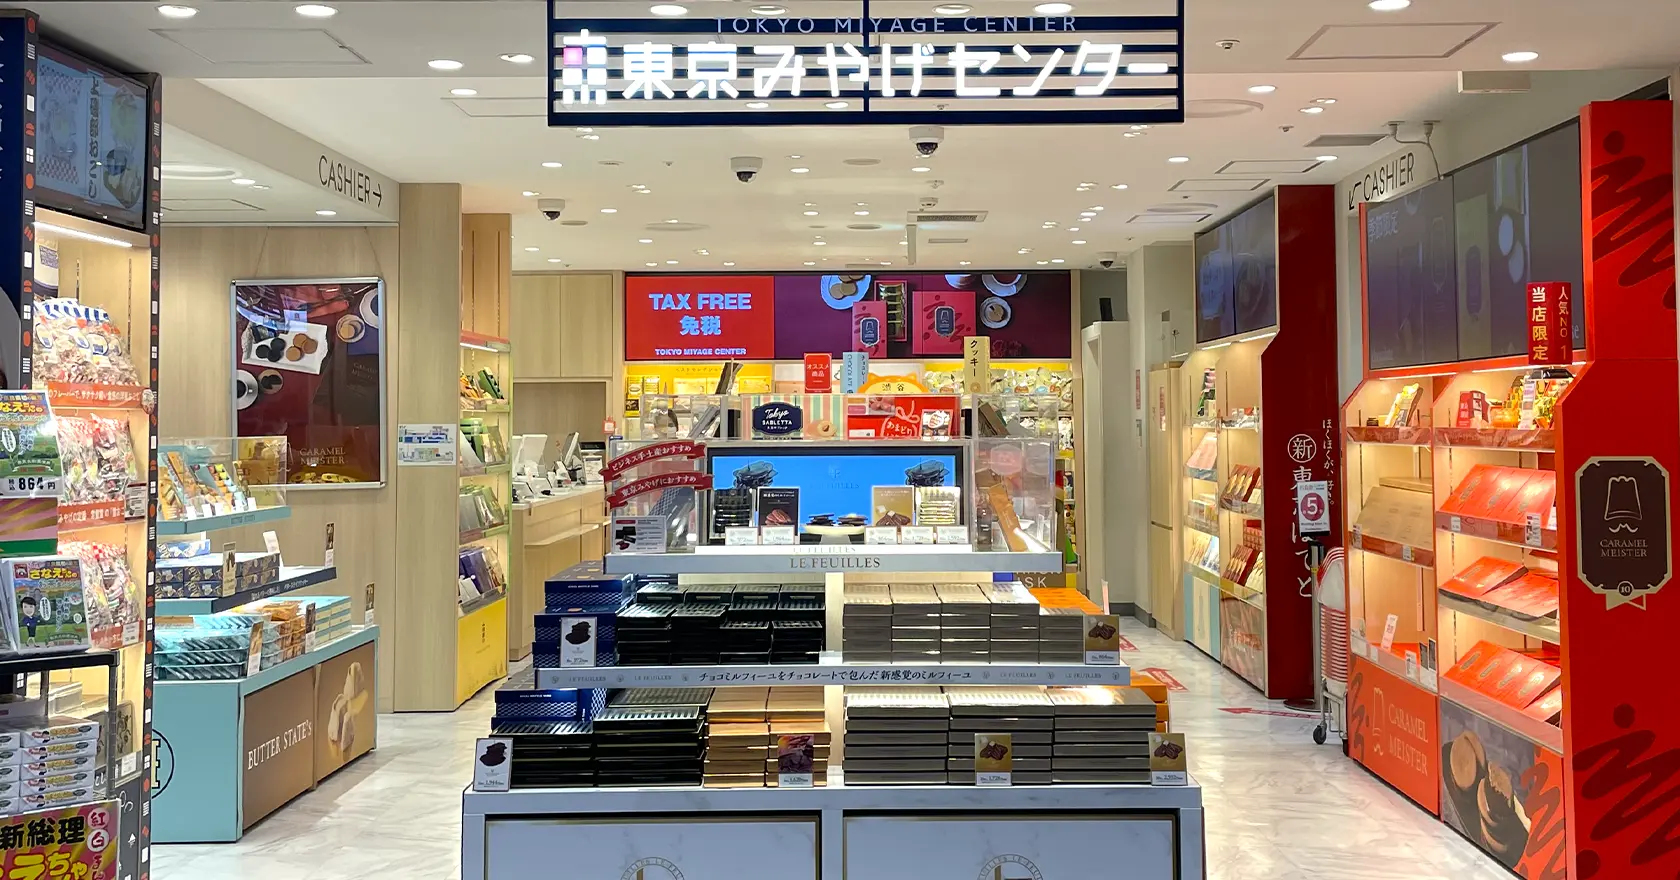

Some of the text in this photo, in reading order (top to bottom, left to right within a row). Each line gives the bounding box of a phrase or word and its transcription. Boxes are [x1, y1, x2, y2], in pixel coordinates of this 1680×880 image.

[714, 16, 1076, 34] TOKYO MIYAGE CENTER
[621, 39, 1169, 100] 東京みやげセンター
[318, 154, 371, 205] CASHIER
[1363, 151, 1415, 202] CASHIER
[648, 293, 752, 310] TAX FREE
[679, 315, 722, 336] 免税
[1532, 286, 1549, 360] 当店限定
[654, 348, 682, 356] TOKYO
[970, 339, 978, 377] クッキー
[882, 383, 905, 393] 渋谷
[887, 421, 913, 435] あまどり
[300, 448, 346, 456] CARAMEL
[611, 445, 692, 471] ビジネス手土産おすすめ
[1292, 436, 1314, 460] 新
[621, 475, 697, 497] 東京みやげにおすすめ
[1307, 496, 1318, 516] 5
[1600, 539, 1648, 548] CARAMEL
[1601, 548, 1647, 557] MEISTER
[790, 557, 880, 568] LE FEUILLES
[1018, 576, 1047, 588] SK
[1388, 703, 1429, 743] CARAMEL
[247, 735, 281, 771] BUTTER
[1388, 735, 1428, 777] MEISTER
[0, 816, 85, 850] 新総理
